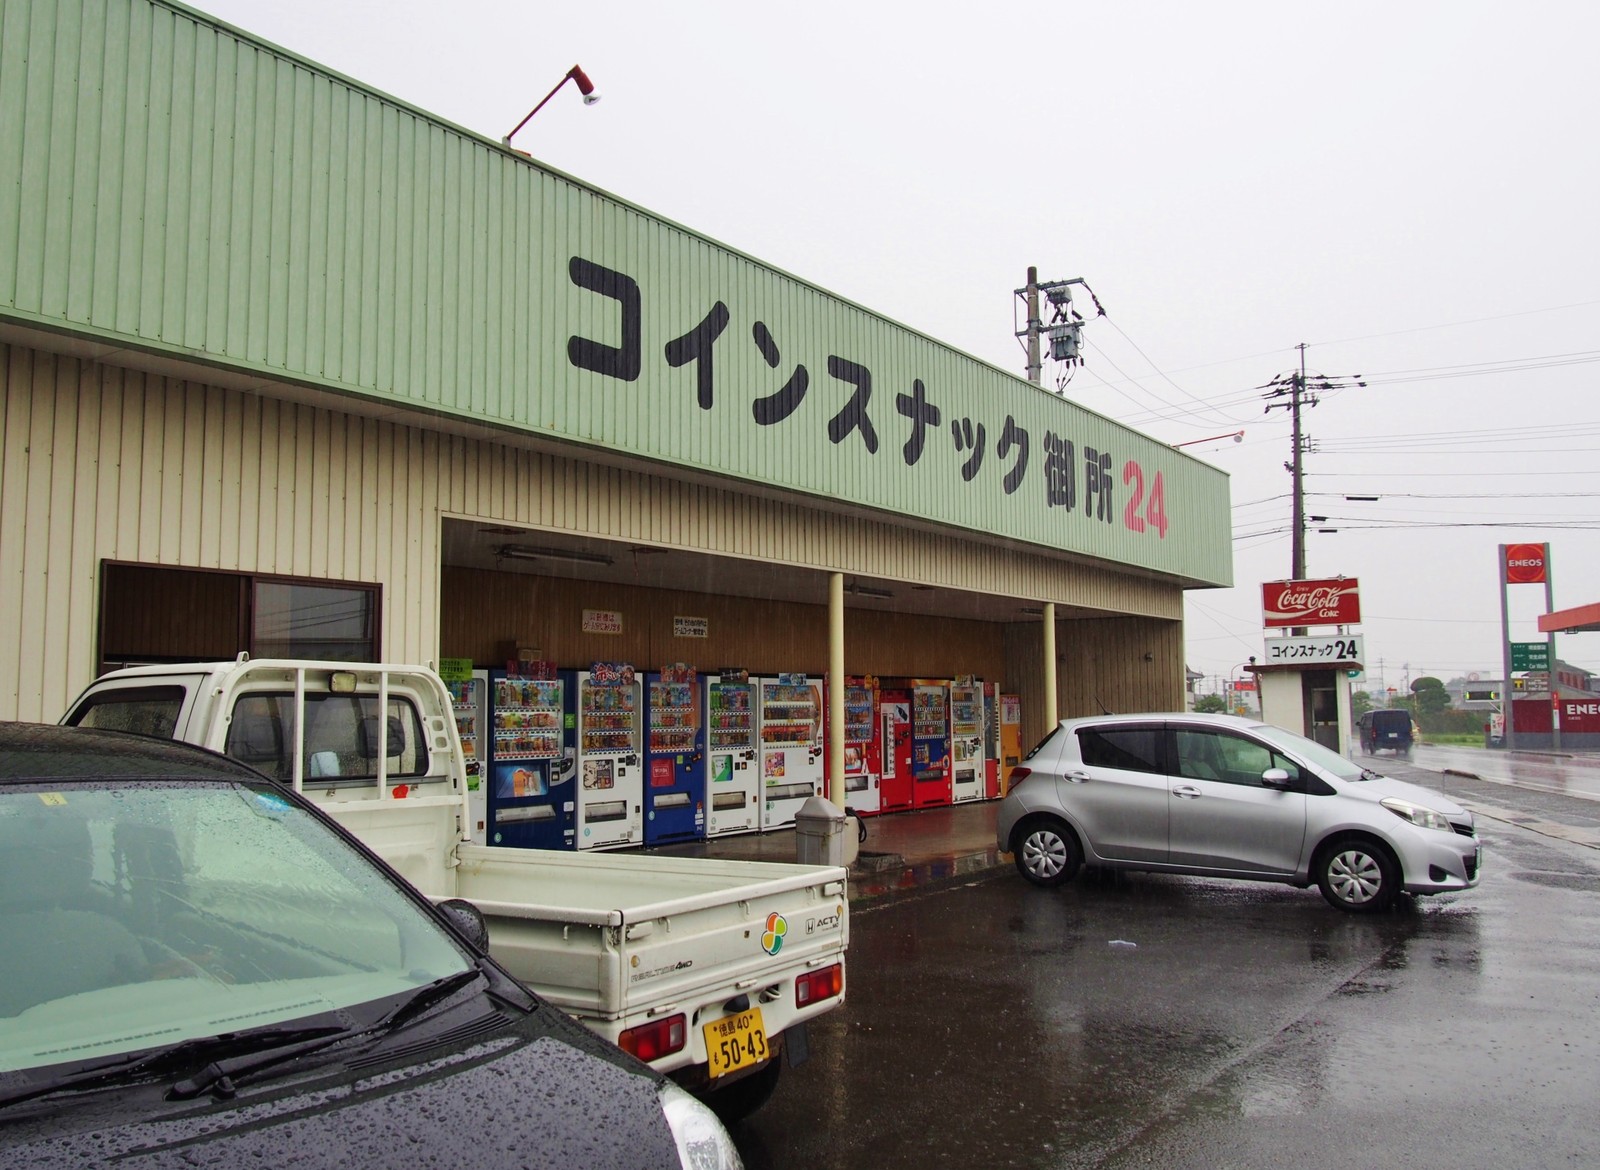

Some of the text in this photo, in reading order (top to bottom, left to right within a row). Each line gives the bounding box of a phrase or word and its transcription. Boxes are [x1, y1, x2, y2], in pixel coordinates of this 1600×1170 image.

[1508, 559, 1542, 567] ENEOS
[1277, 587, 1341, 610] Coca-Cola
[1319, 608, 1340, 618] Coke
[817, 915, 840, 927] ACTY
[675, 960, 693, 970] 4WD
[719, 1015, 750, 1037] 徳島 40
[721, 1029, 765, 1069] 50-43
